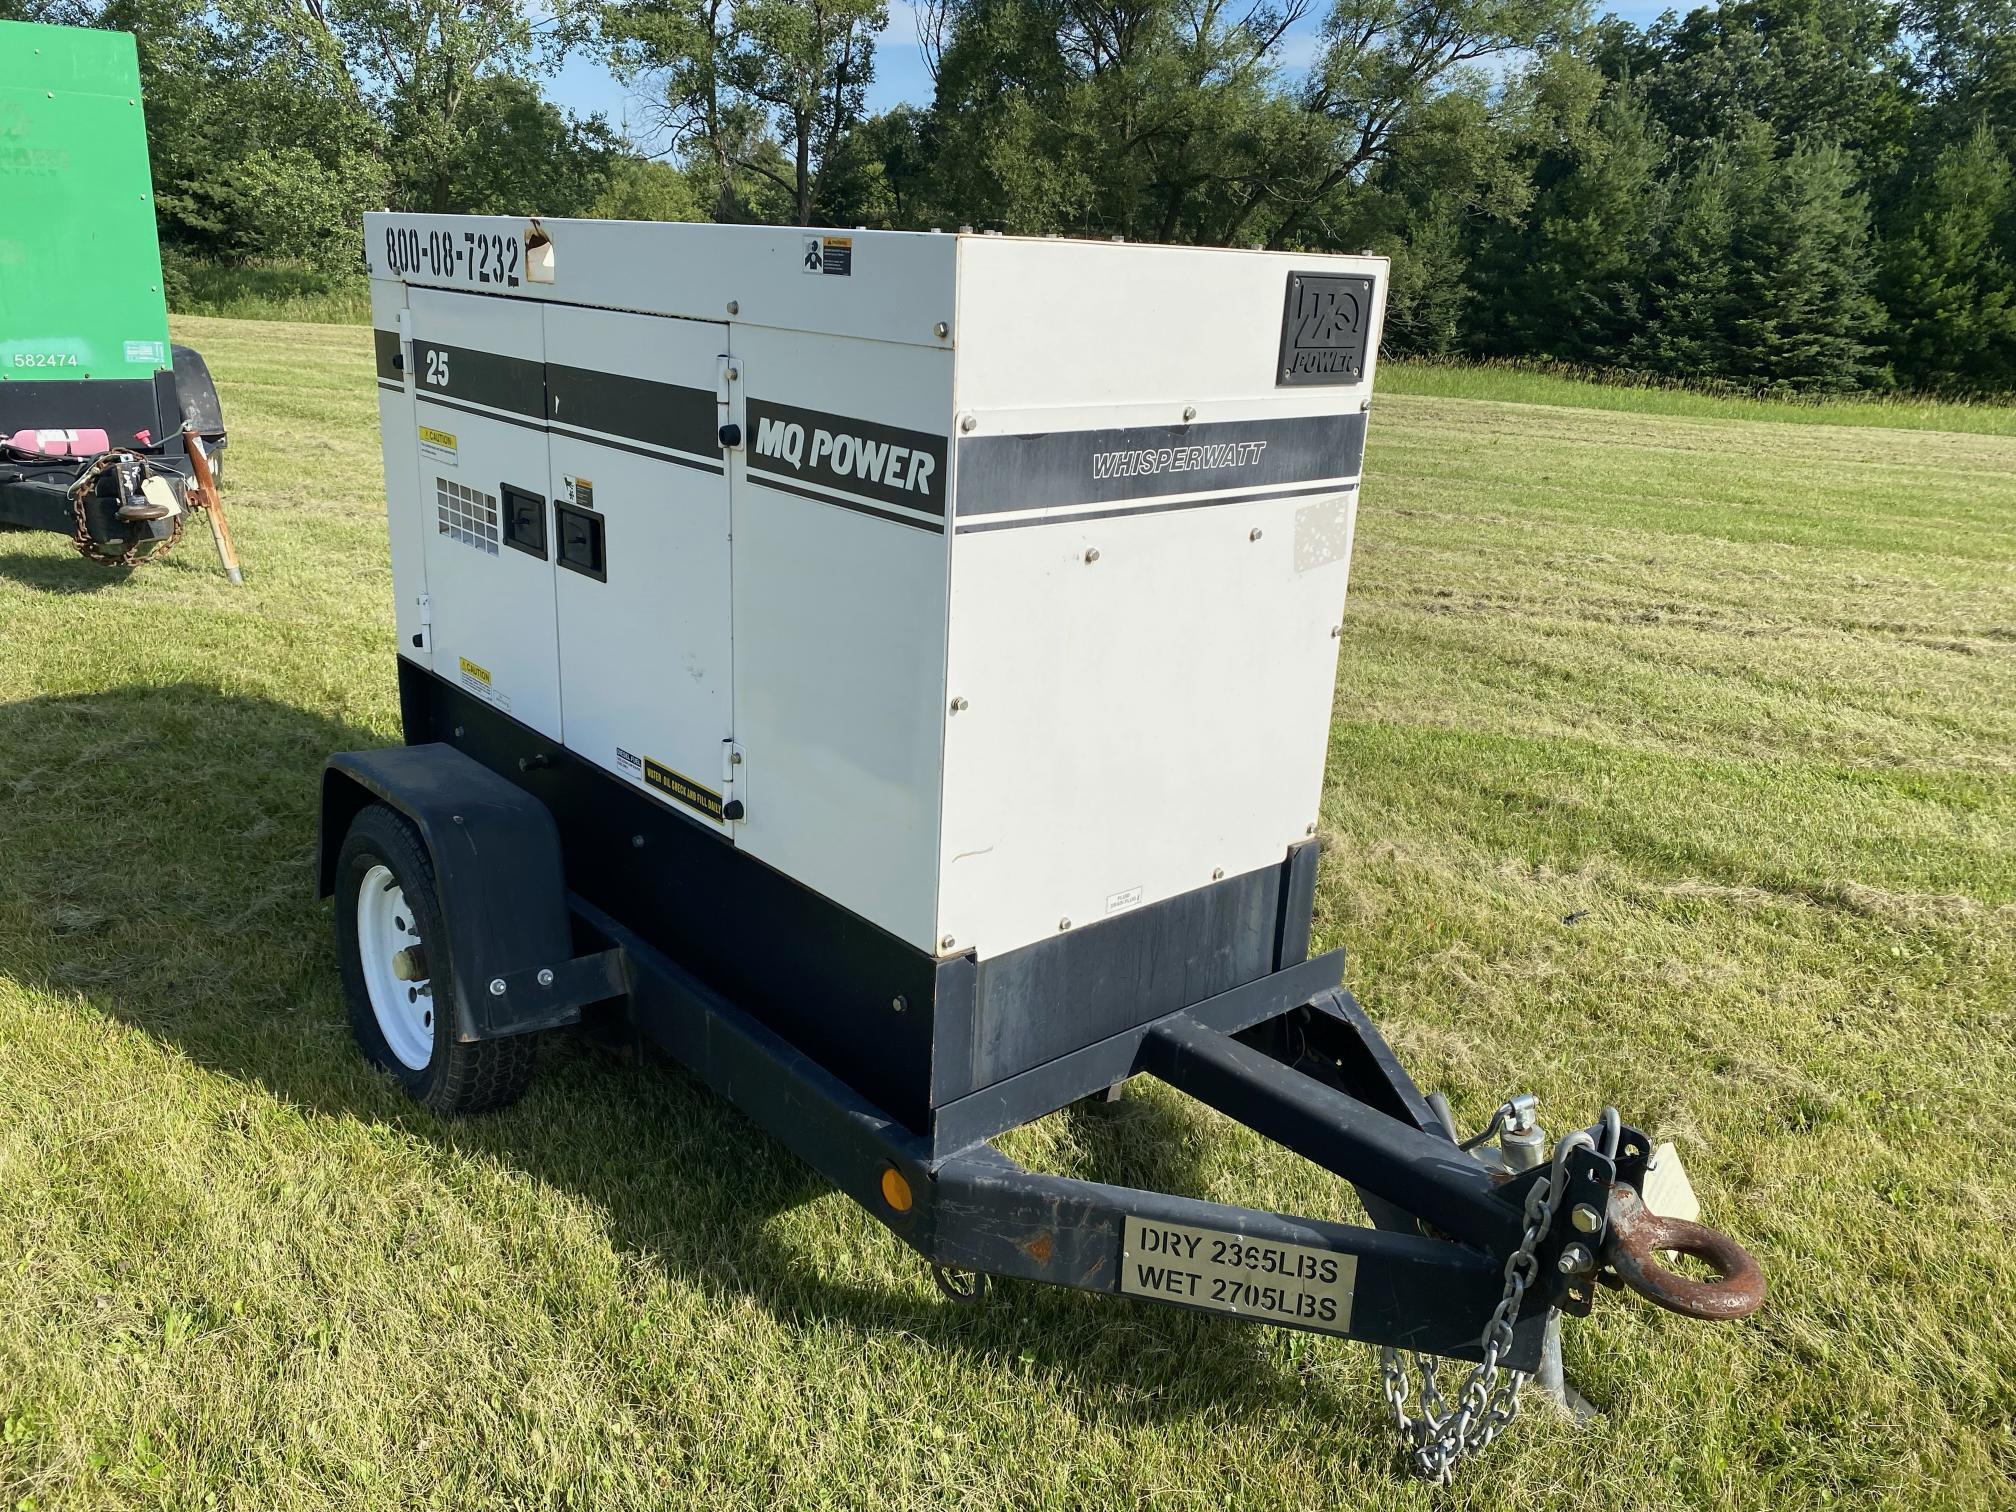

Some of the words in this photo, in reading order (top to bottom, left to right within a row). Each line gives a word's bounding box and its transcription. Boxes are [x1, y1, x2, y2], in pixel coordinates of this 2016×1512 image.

[386, 227, 519, 287] 800-08-7232
[14, 354, 78, 367] 582474
[426, 350, 449, 386] 25
[1292, 352, 1353, 373] POWER
[430, 431, 452, 446] CAUTION
[755, 417, 805, 471] MQ
[809, 428, 935, 495] POWER
[1093, 441, 1267, 479] WHISPERWATT
[466, 663, 490, 682] CAUTION
[671, 780, 687, 796] CHECK
[687, 788, 697, 801] AND
[697, 793, 707, 808] FILL
[707, 799, 721, 815] DAILY
[1140, 1228, 1202, 1259] DRY
[1210, 1240, 1338, 1283] 2365LBS
[1137, 1264, 1202, 1296] WET
[1210, 1278, 1337, 1321] 2705LBS
